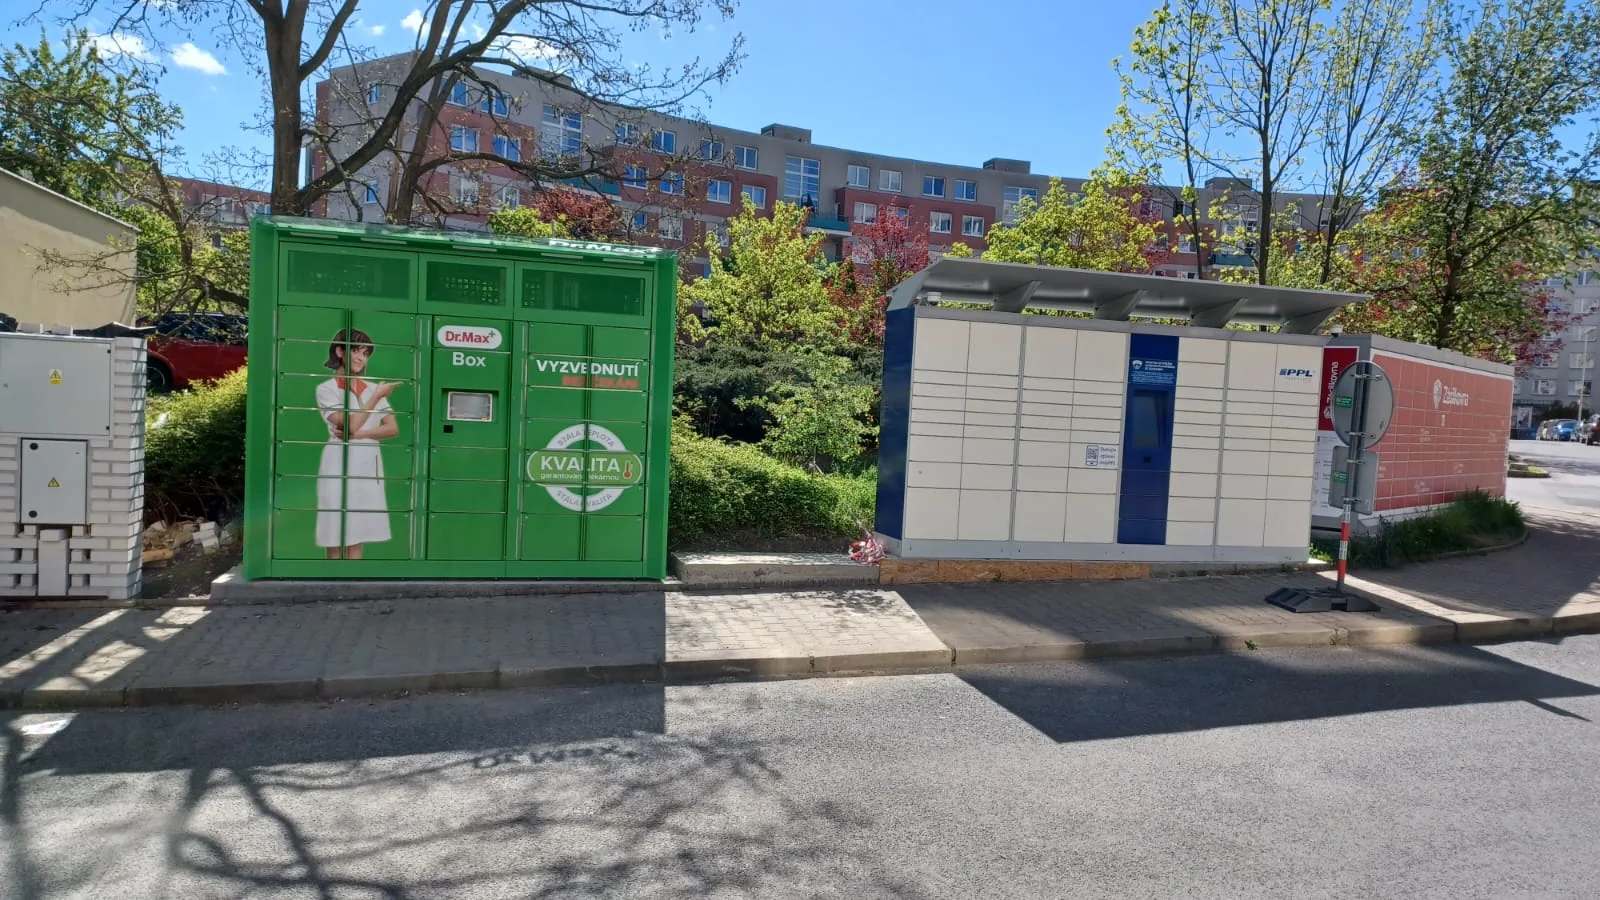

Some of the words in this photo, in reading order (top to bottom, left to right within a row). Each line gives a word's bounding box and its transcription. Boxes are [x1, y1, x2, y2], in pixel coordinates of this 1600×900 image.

[452, 351, 487, 367] Box
[536, 359, 640, 377] VYZVEDNUTÍ
[1286, 368, 1313, 378] PPL
[541, 455, 620, 473] KVALITA
[540, 473, 583, 481] garantovan
[581, 493, 613, 507] VALITA
